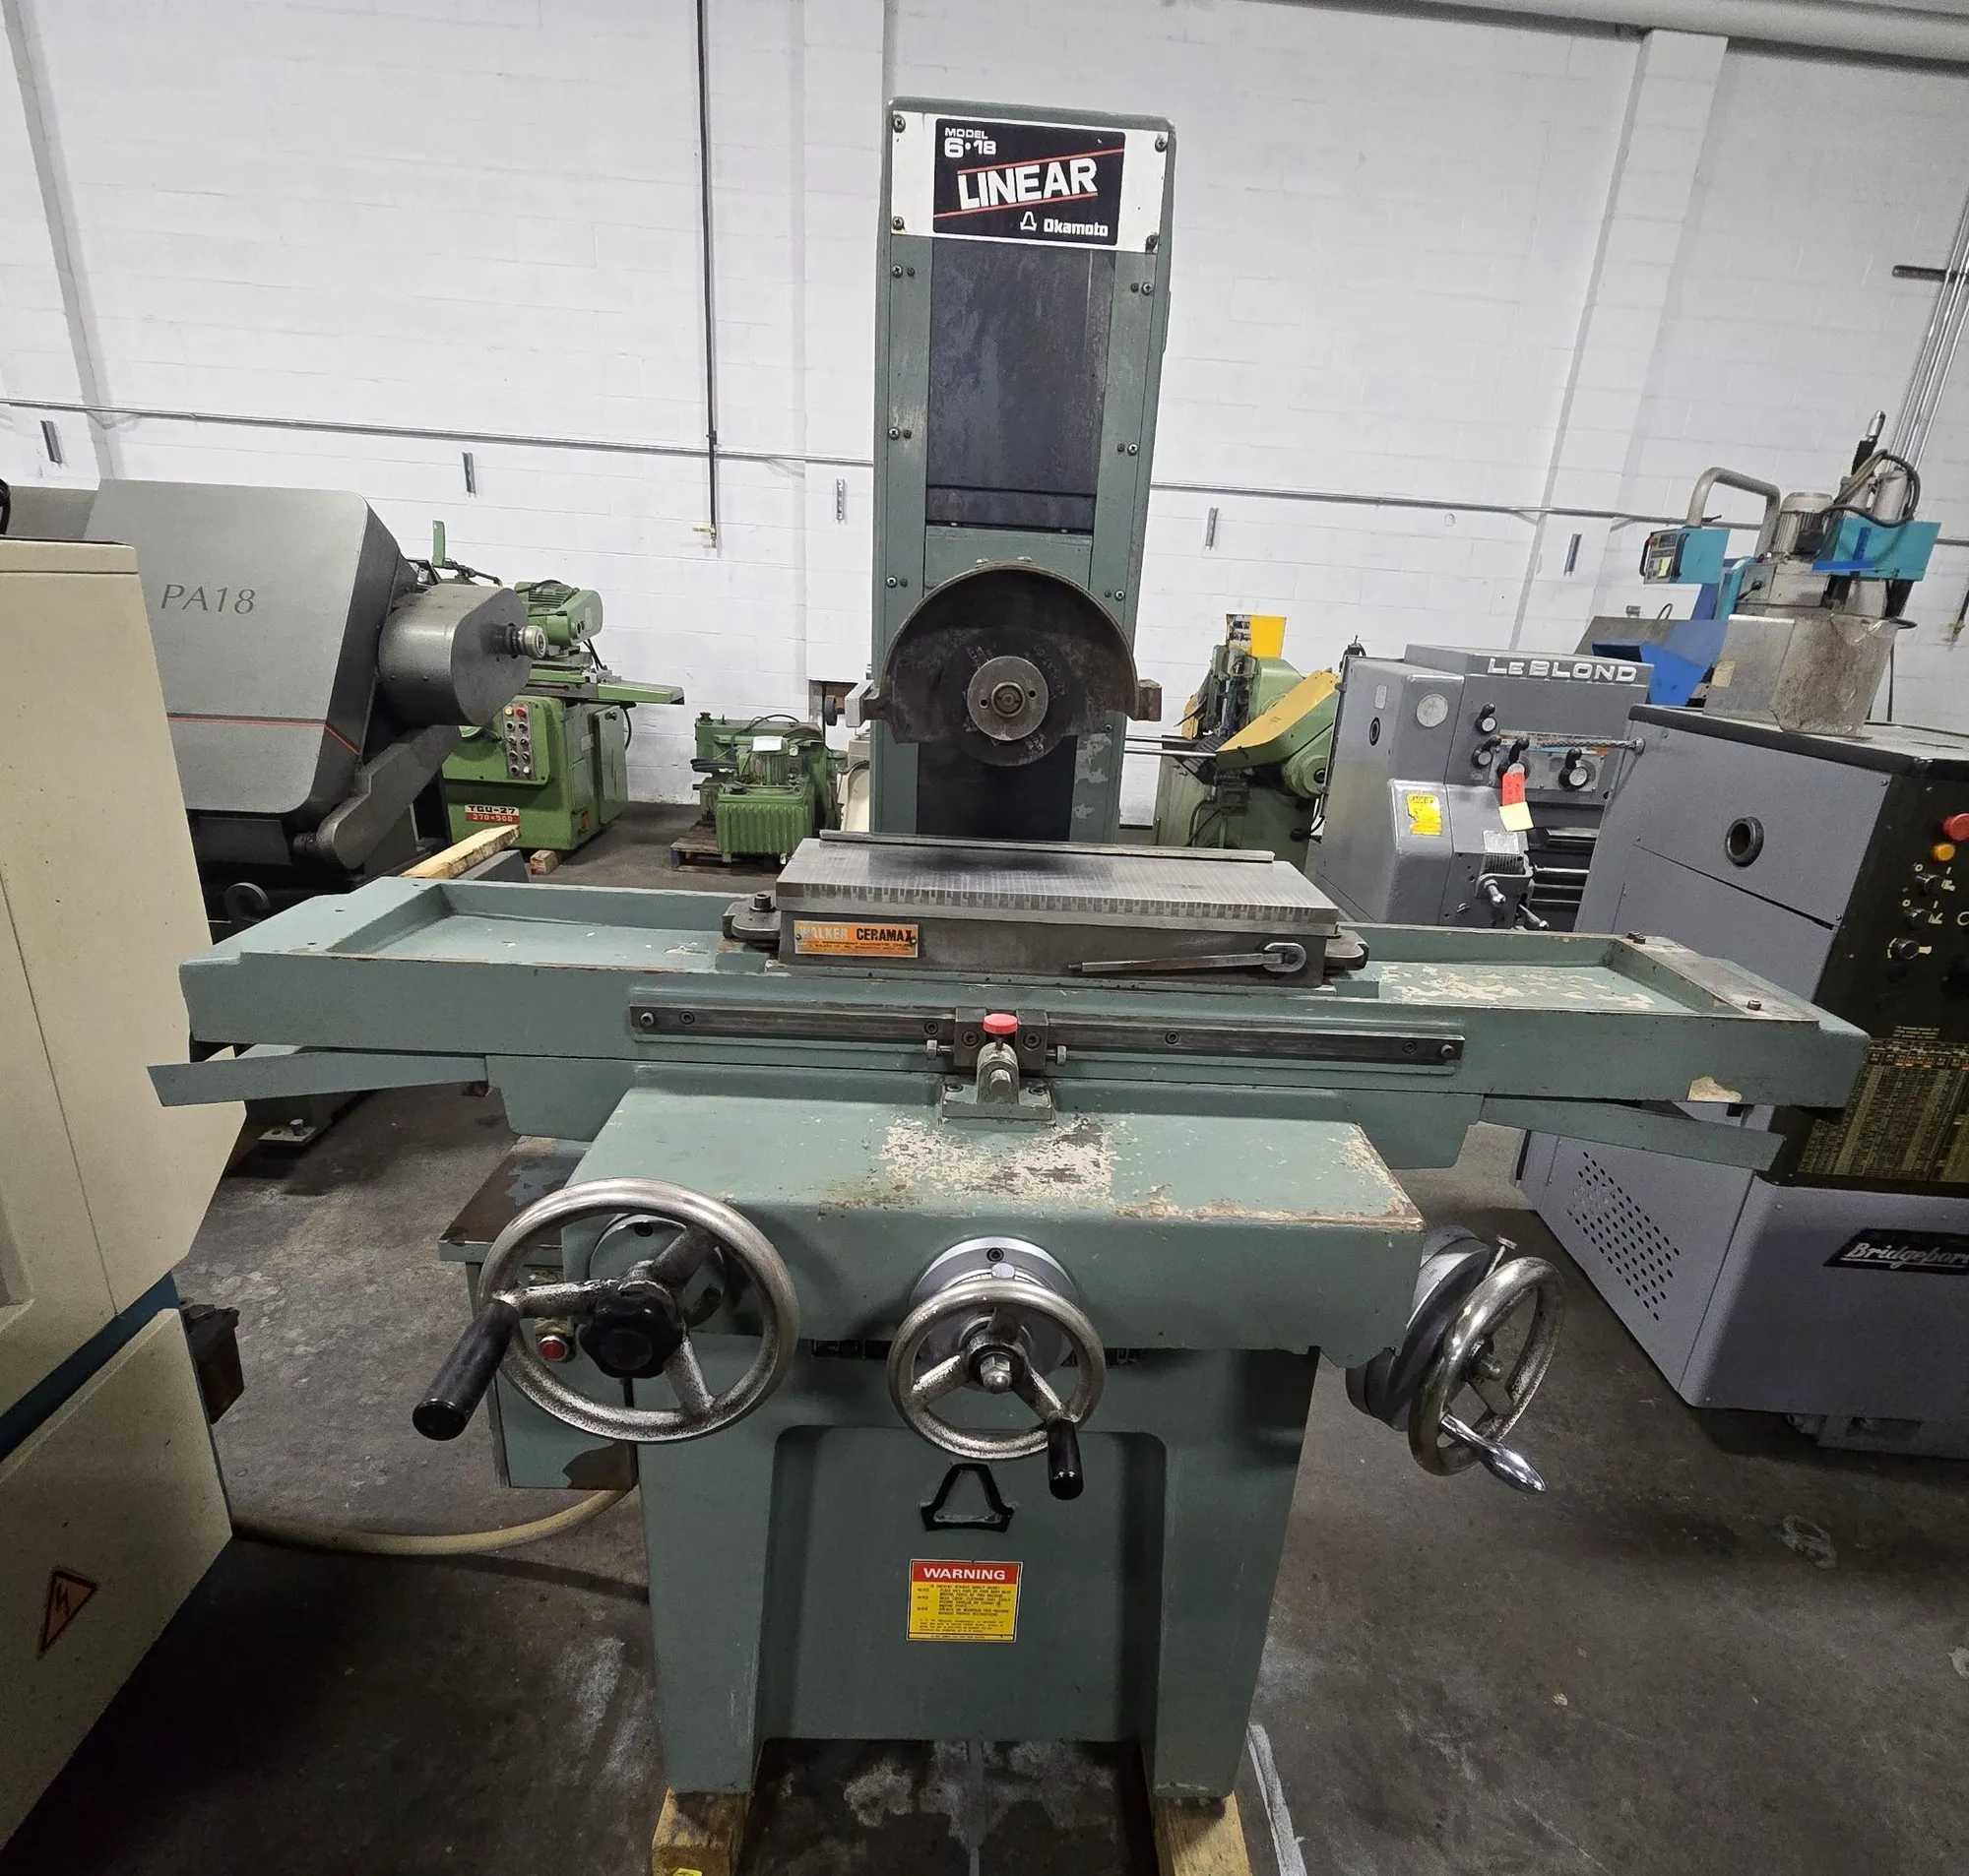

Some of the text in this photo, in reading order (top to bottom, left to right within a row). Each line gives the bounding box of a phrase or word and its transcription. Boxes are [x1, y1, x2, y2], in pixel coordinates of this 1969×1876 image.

[945, 127, 989, 140] MODEL
[957, 157, 1099, 210] LINEAR
[1044, 218, 1109, 236] Okamoto
[160, 584, 256, 615] PA18
[856, 927, 914, 942] CERAMAX
[1840, 1241, 1969, 1270] Bridgepor
[922, 1567, 1006, 1581] WARNING
